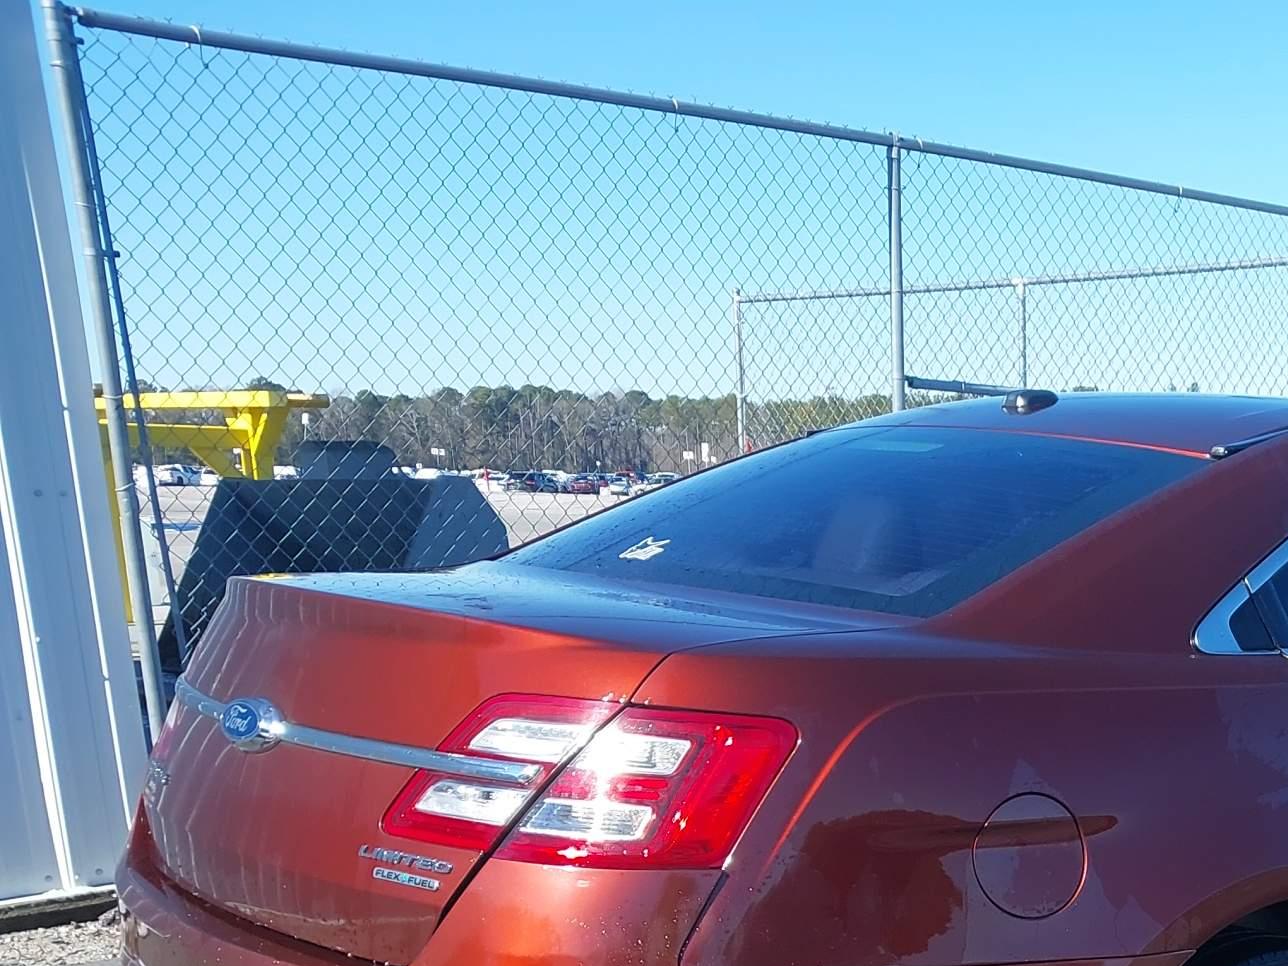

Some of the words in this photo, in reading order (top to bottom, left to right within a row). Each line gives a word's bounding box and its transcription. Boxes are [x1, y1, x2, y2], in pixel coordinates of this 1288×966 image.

[226, 704, 252, 732] Ford
[358, 844, 453, 874] LIMITED
[374, 868, 400, 881] FLEX
[407, 876, 435, 889] FUEL
